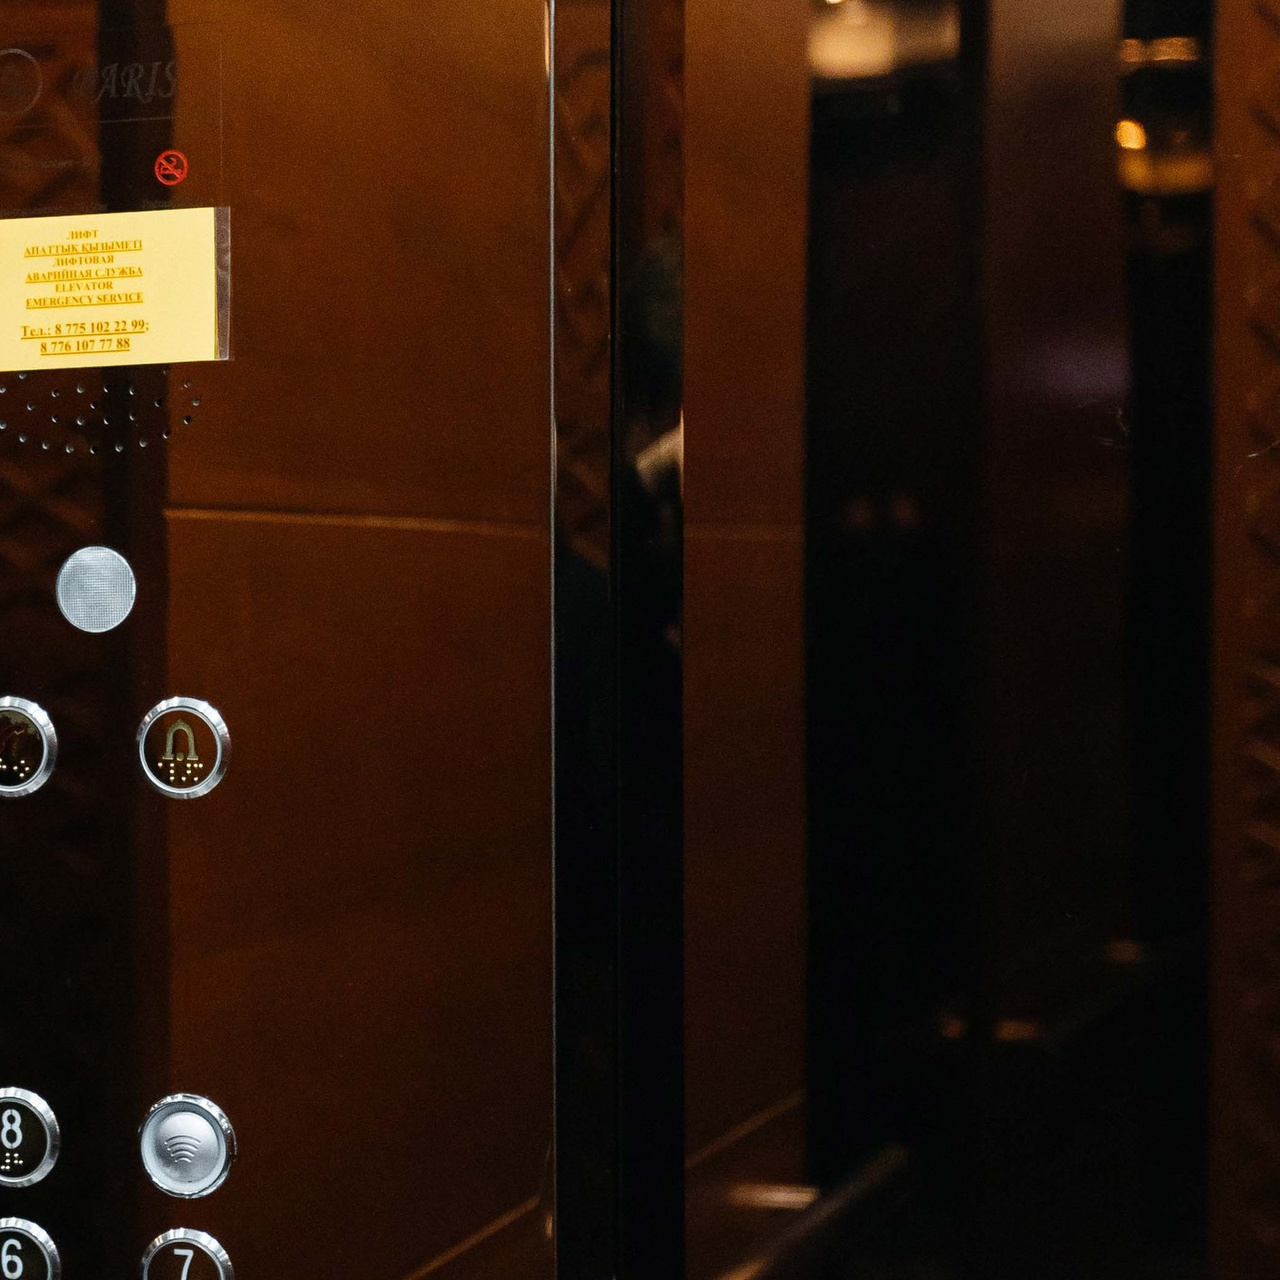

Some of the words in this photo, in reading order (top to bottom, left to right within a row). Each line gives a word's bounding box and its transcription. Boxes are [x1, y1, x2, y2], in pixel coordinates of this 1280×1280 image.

[66, 229, 100, 240] ЛИФТ
[52, 254, 114, 267] ЛИФТОВАЯ
[25, 268, 92, 281] АВАРИЙНАЯ
[95, 265, 143, 278] СЛУЖБА
[55, 281, 114, 293] ELEVATOR
[26, 295, 92, 308] EMERGENCY
[97, 292, 143, 304] SERVICE
[55, 323, 62, 335] 8
[65, 322, 86, 334] 775
[91, 321, 110, 333] 102
[114, 320, 128, 332] 22
[40, 341, 48, 353] 8
[51, 340, 72, 352] 776
[76, 339, 95, 351] 107
[100, 338, 113, 350] 77
[116, 337, 131, 349] 88
[1, 1109, 23, 1150] 8
[1, 1238, 23, 1280] 6
